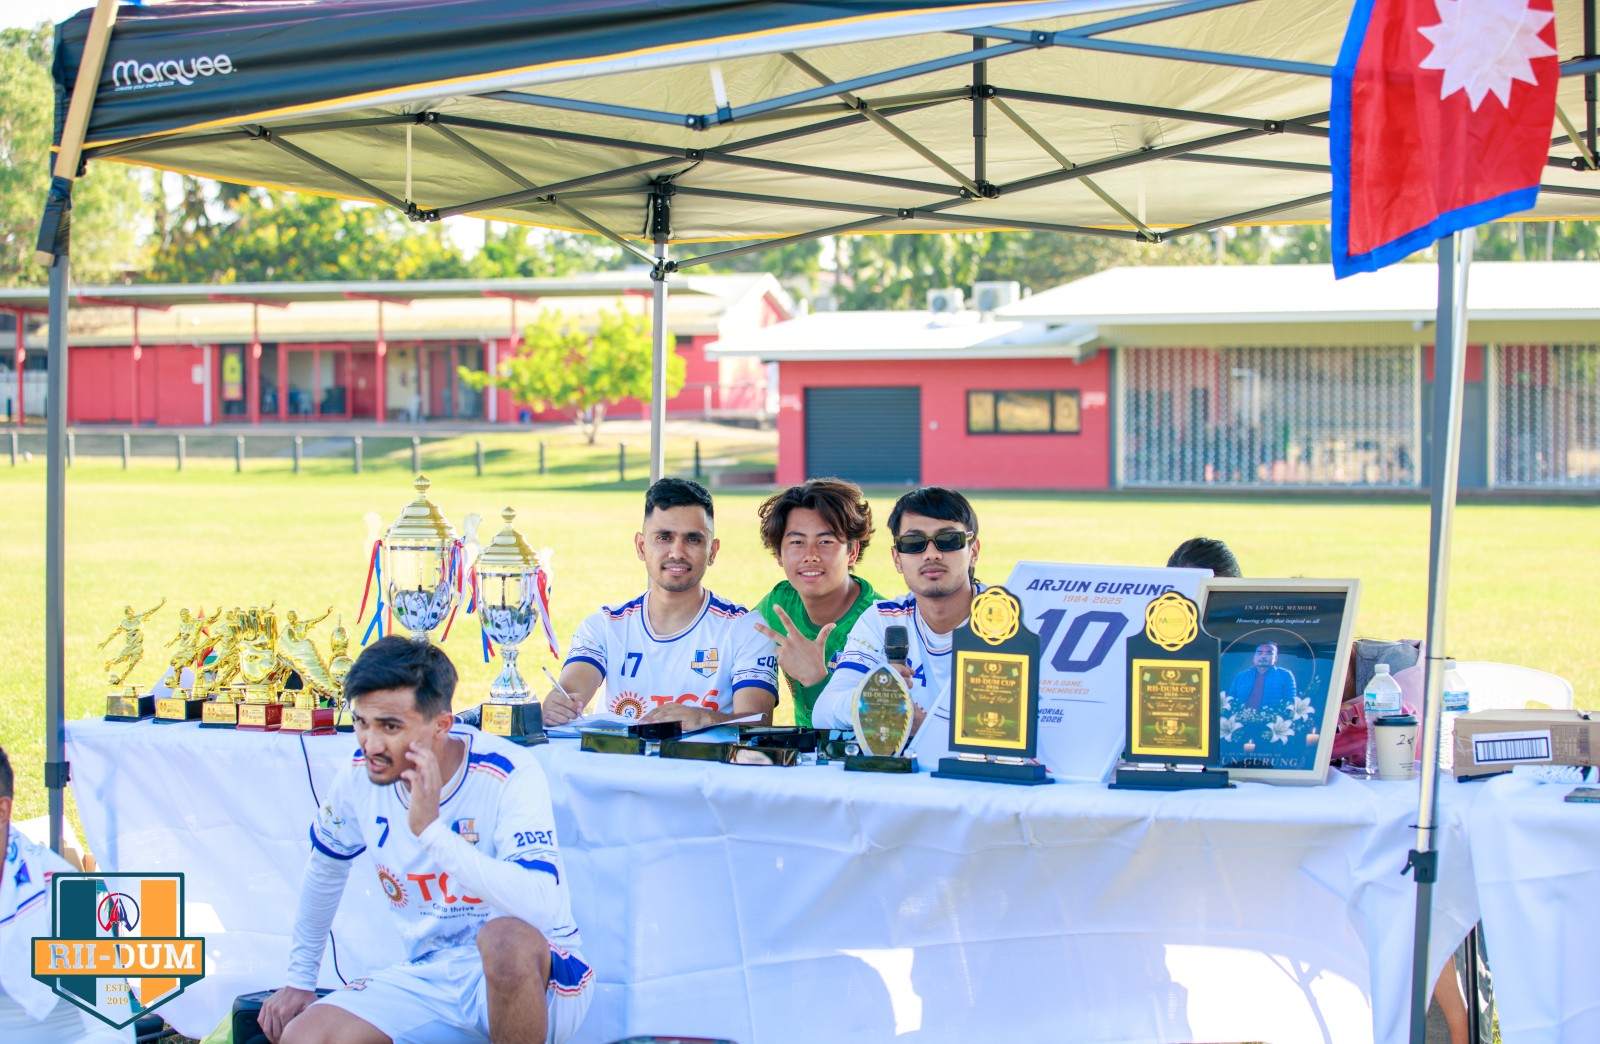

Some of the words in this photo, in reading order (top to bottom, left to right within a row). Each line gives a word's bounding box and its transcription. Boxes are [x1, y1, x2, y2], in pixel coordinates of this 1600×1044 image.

[1026, 579, 1092, 592] ARJUN
[1094, 582, 1175, 596] GURUNG
[1036, 608, 1129, 673] 10
[1040, 715, 1063, 723] 2026
[1243, 758, 1298, 768] GURUNG
[376, 816, 390, 848] 7
[407, 872, 484, 904] TC
